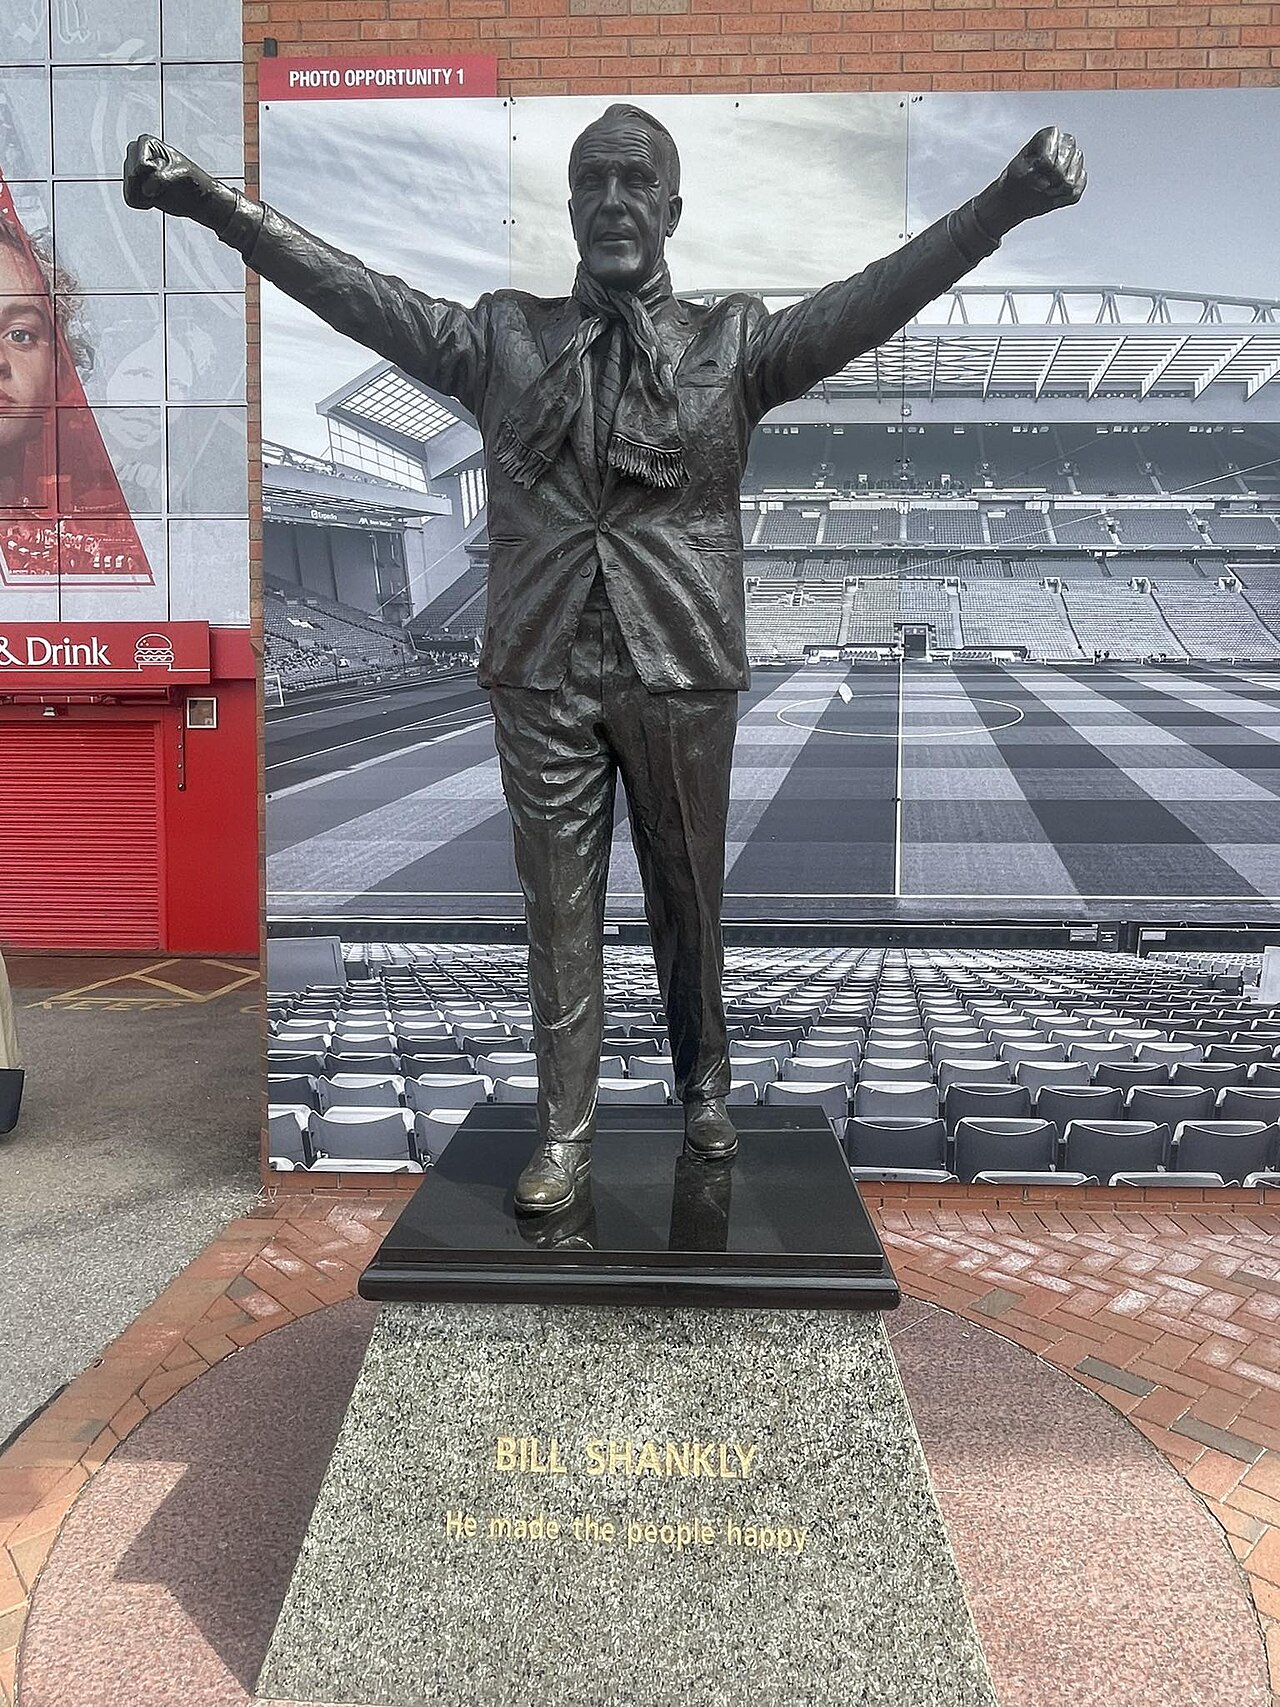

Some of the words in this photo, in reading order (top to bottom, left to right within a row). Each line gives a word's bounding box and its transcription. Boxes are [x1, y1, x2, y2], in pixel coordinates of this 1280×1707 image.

[289, 70, 340, 87] PHOTO
[344, 69, 453, 87] OPPORTUNITY
[457, 68, 464, 85] 1
[25, 636, 112, 666] Drink
[496, 1436, 567, 1474] BILL
[585, 1440, 757, 1479] SHANKLY
[446, 1510, 477, 1538] He
[488, 1513, 560, 1541] made
[572, 1514, 615, 1543] the
[627, 1518, 716, 1551] people
[726, 1518, 808, 1553] happy
